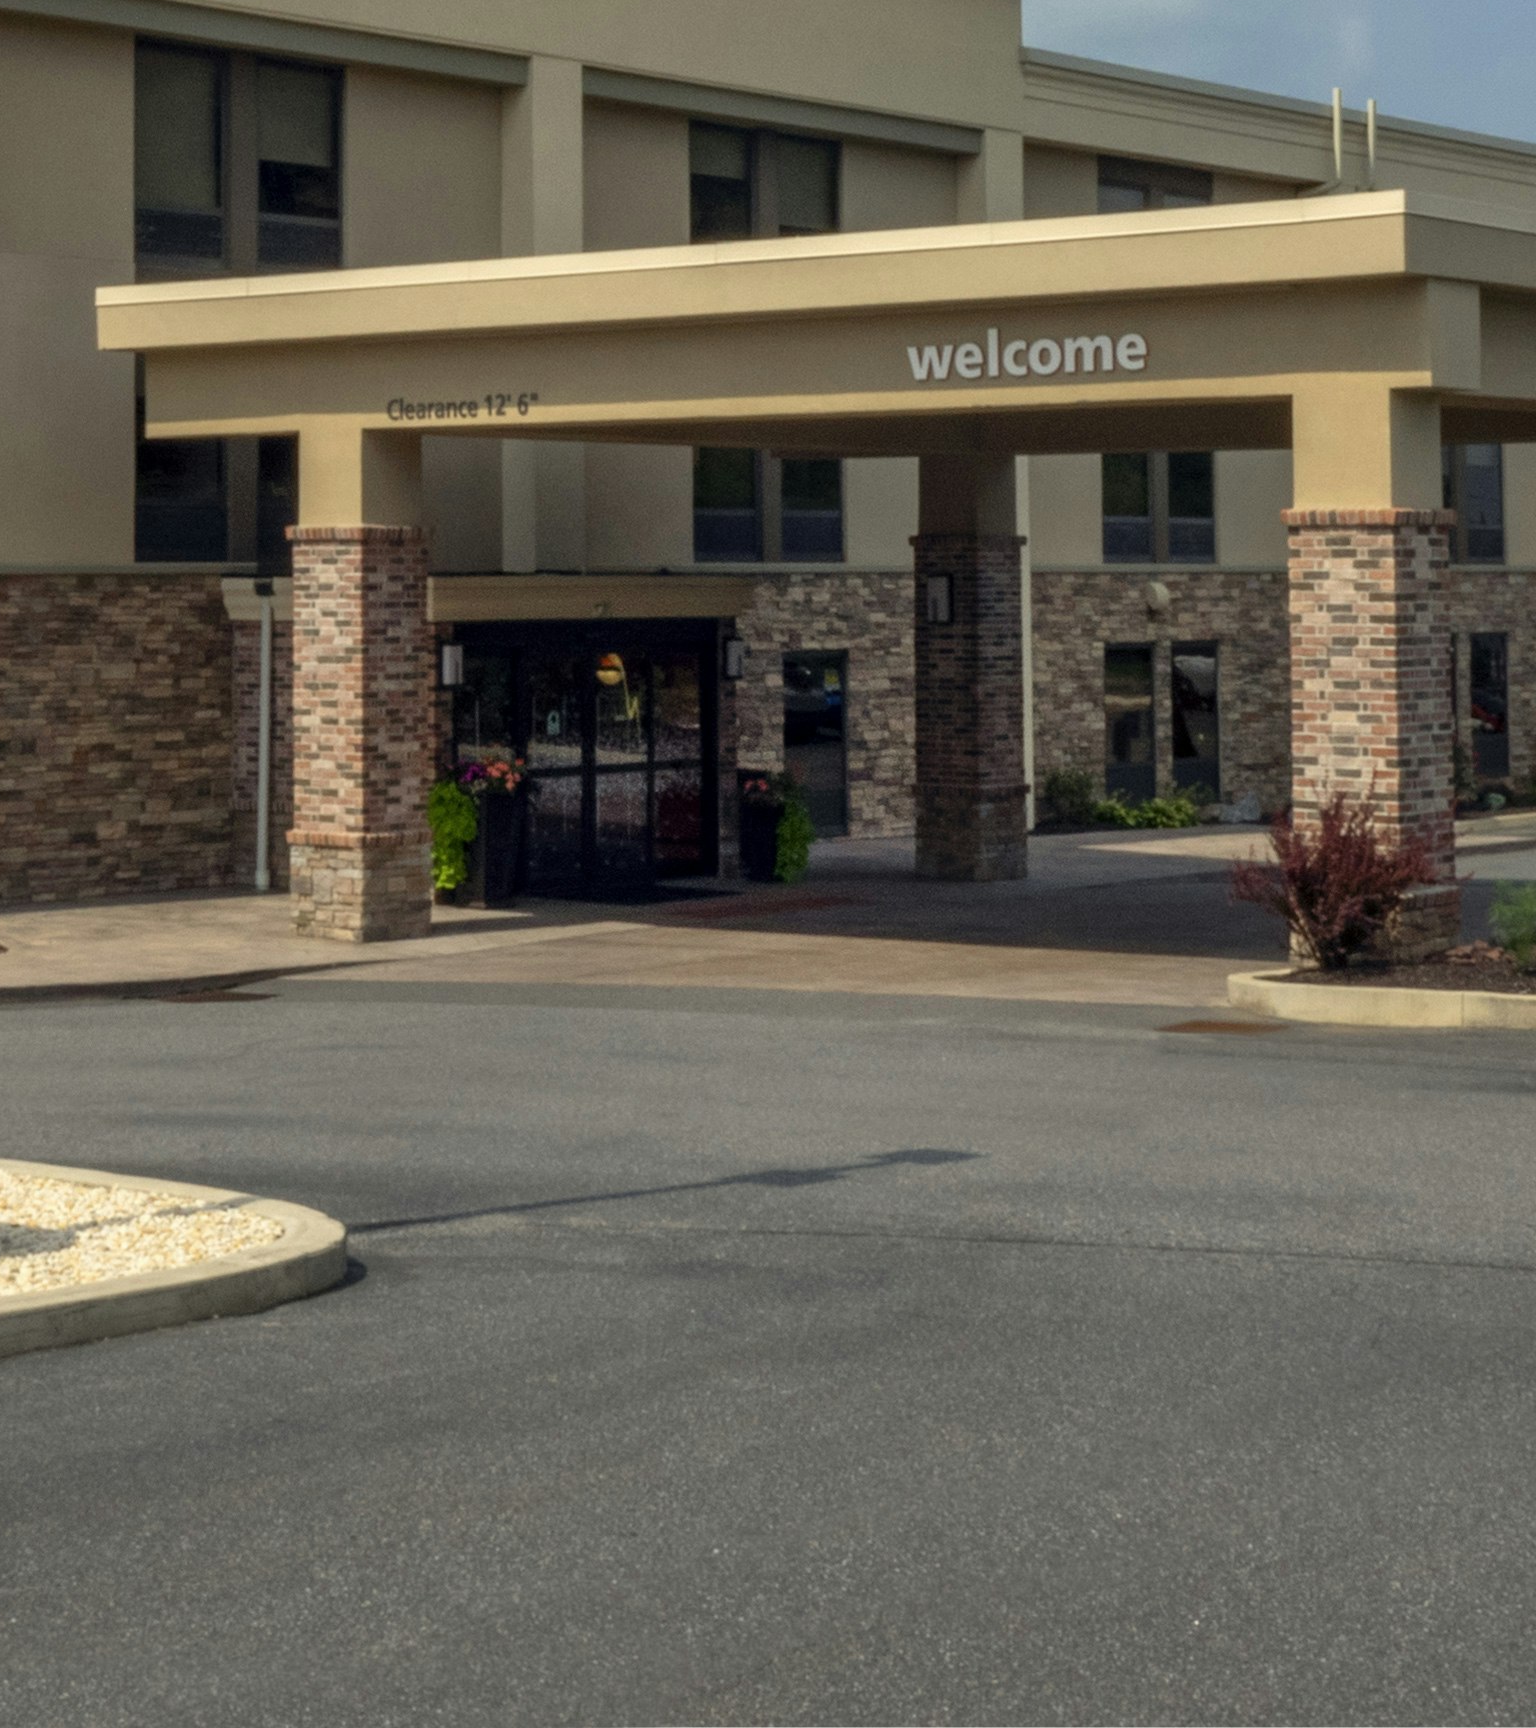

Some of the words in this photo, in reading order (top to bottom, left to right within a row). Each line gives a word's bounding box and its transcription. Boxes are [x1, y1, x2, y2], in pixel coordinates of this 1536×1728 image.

[907, 327, 1148, 381] welcome
[387, 397, 478, 421] Clearance
[483, 394, 511, 416] 12'
[517, 392, 539, 416] 6"
